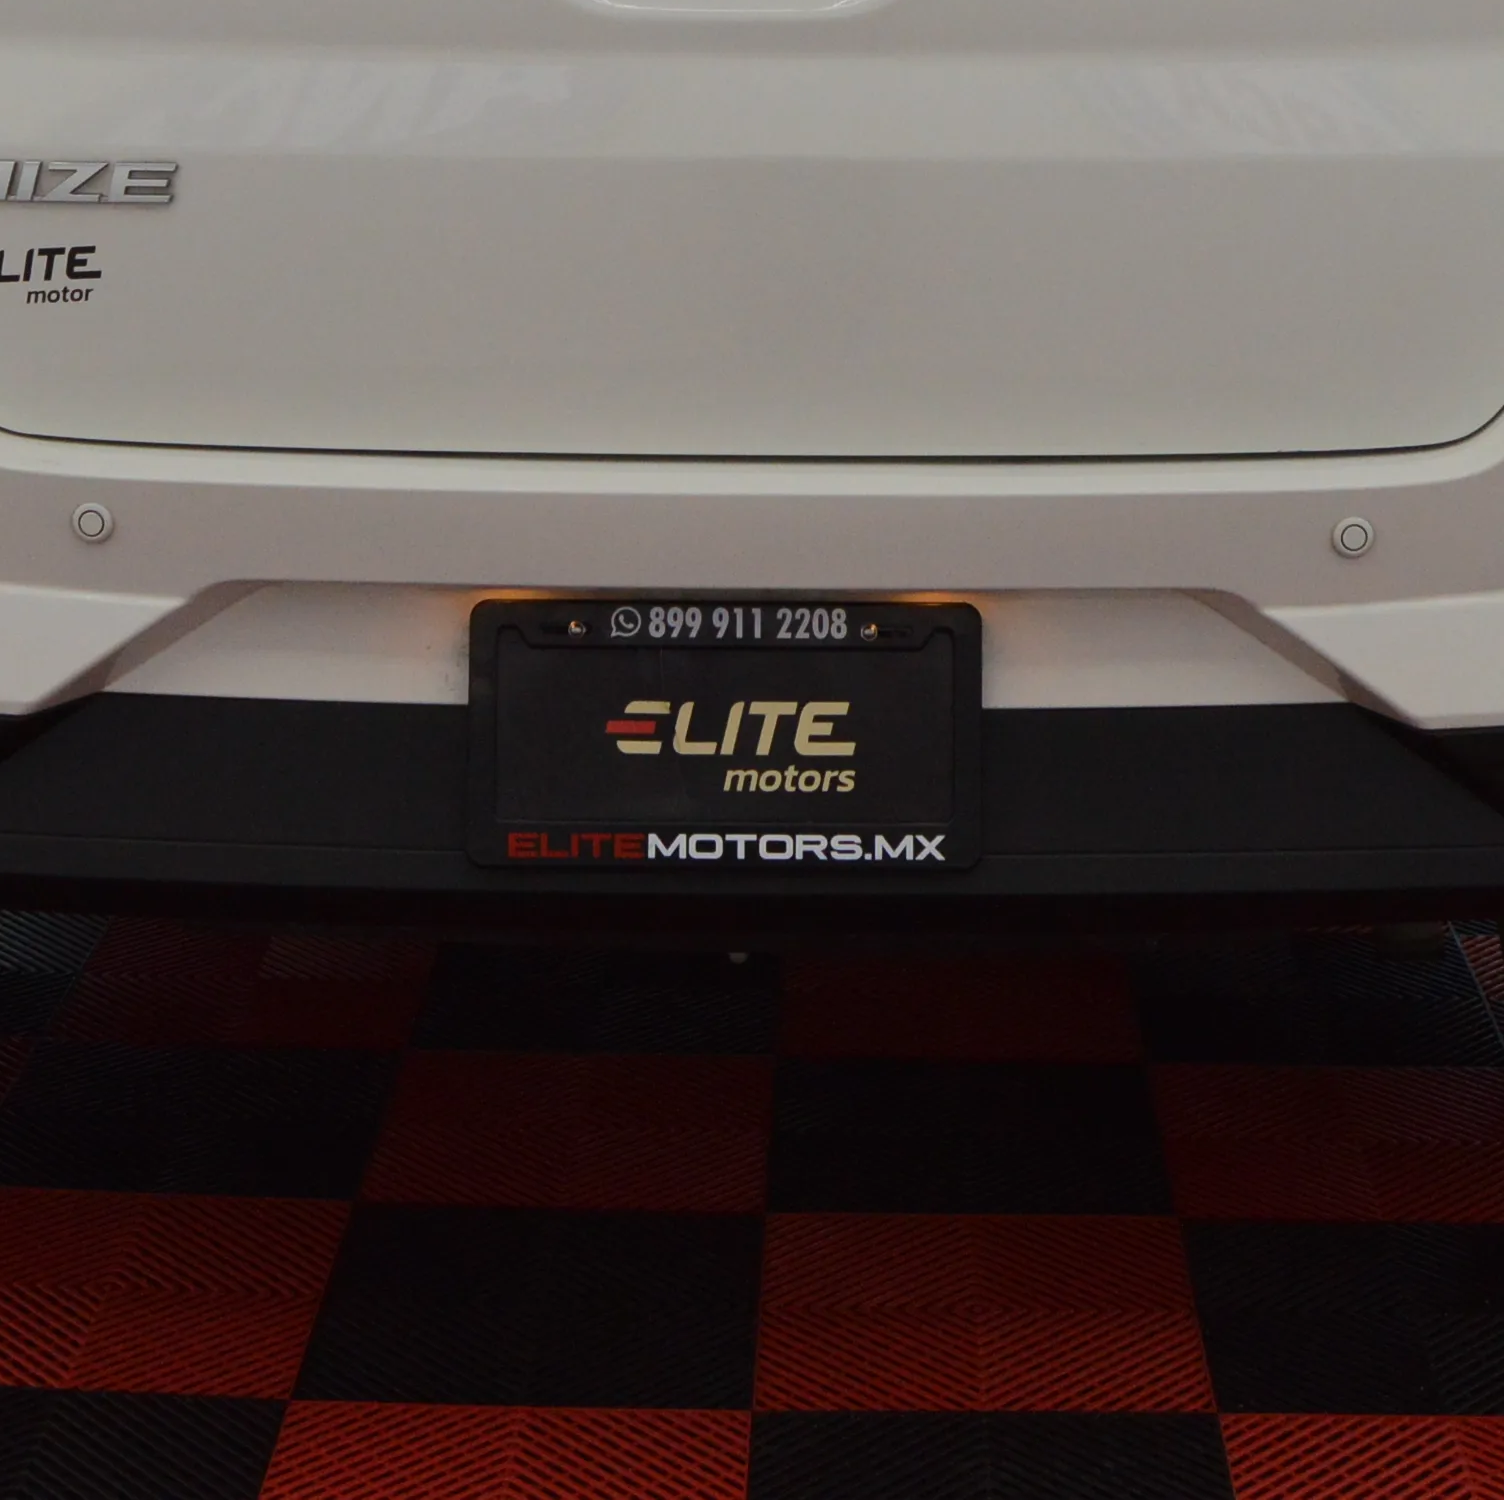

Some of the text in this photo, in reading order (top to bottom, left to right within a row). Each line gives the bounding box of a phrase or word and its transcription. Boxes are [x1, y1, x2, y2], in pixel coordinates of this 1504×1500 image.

[26, 286, 94, 304] motor
[648, 606, 848, 641] 899 911 2208
[605, 700, 857, 756] ELITE
[723, 764, 856, 793] motors
[507, 832, 946, 861] ELITEMOTORS.MX
